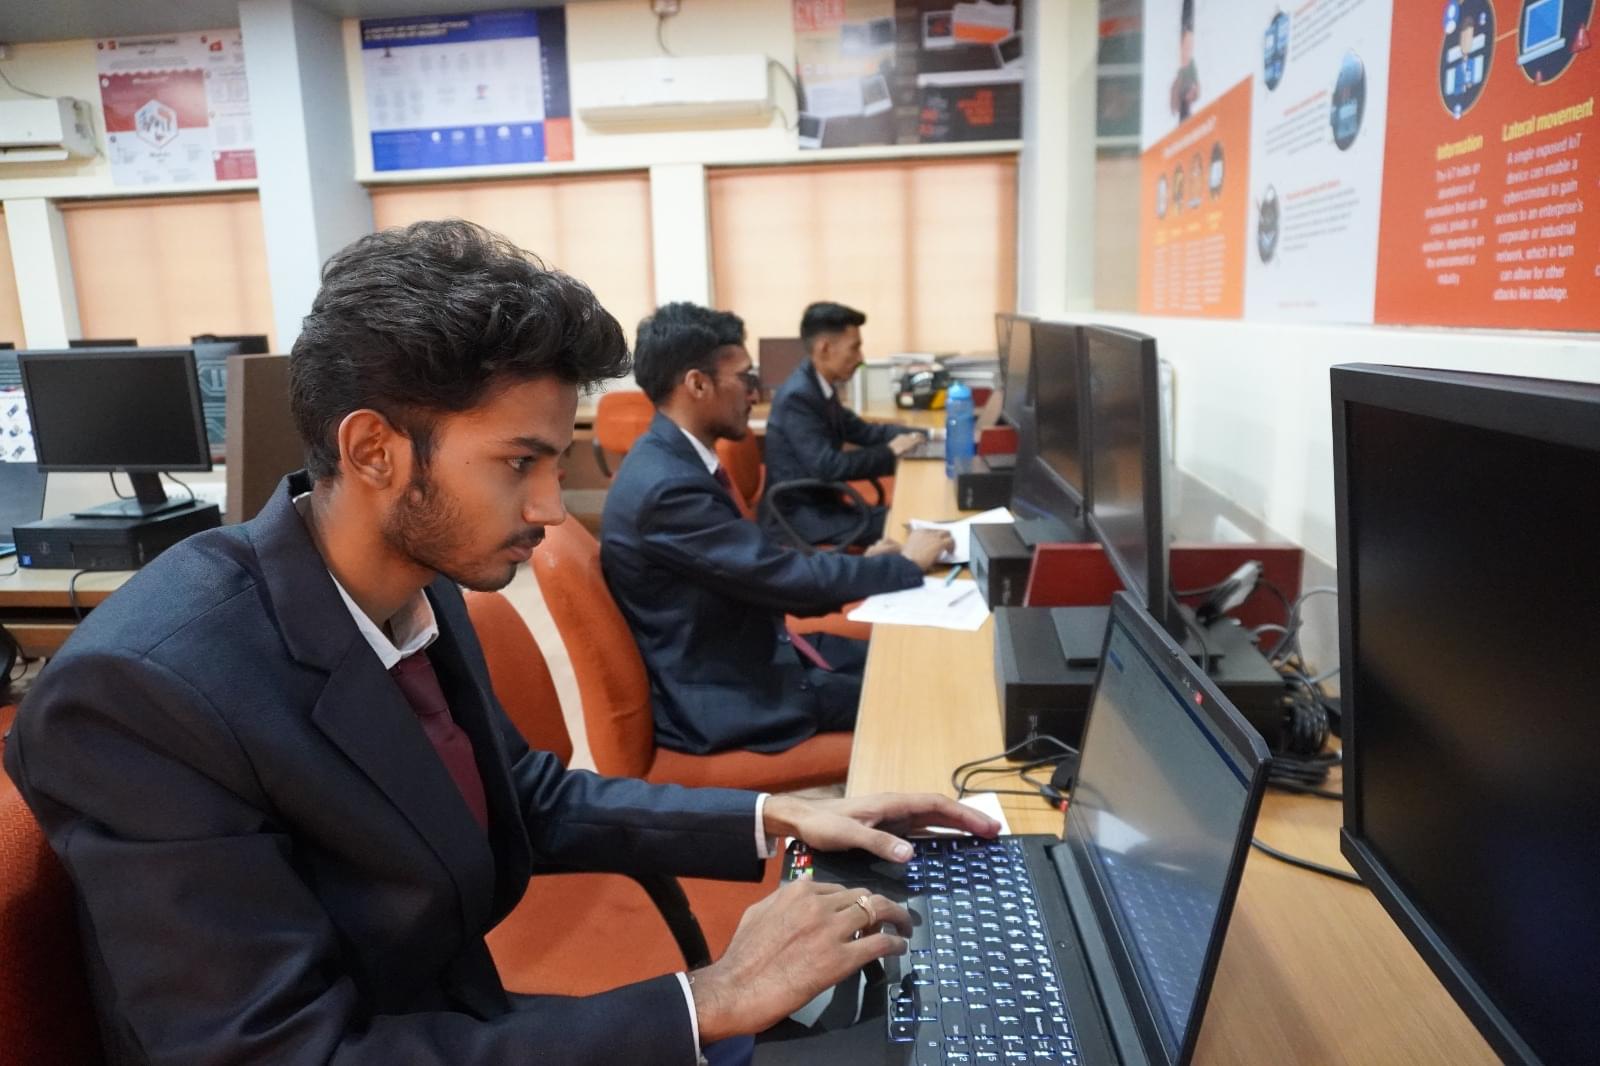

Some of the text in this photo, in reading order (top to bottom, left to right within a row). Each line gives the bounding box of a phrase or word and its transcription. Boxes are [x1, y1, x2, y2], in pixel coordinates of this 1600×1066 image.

[1502, 96, 1594, 141] Lateral movement
[1437, 134, 1483, 160] Information
[1535, 137, 1567, 157] exposed
